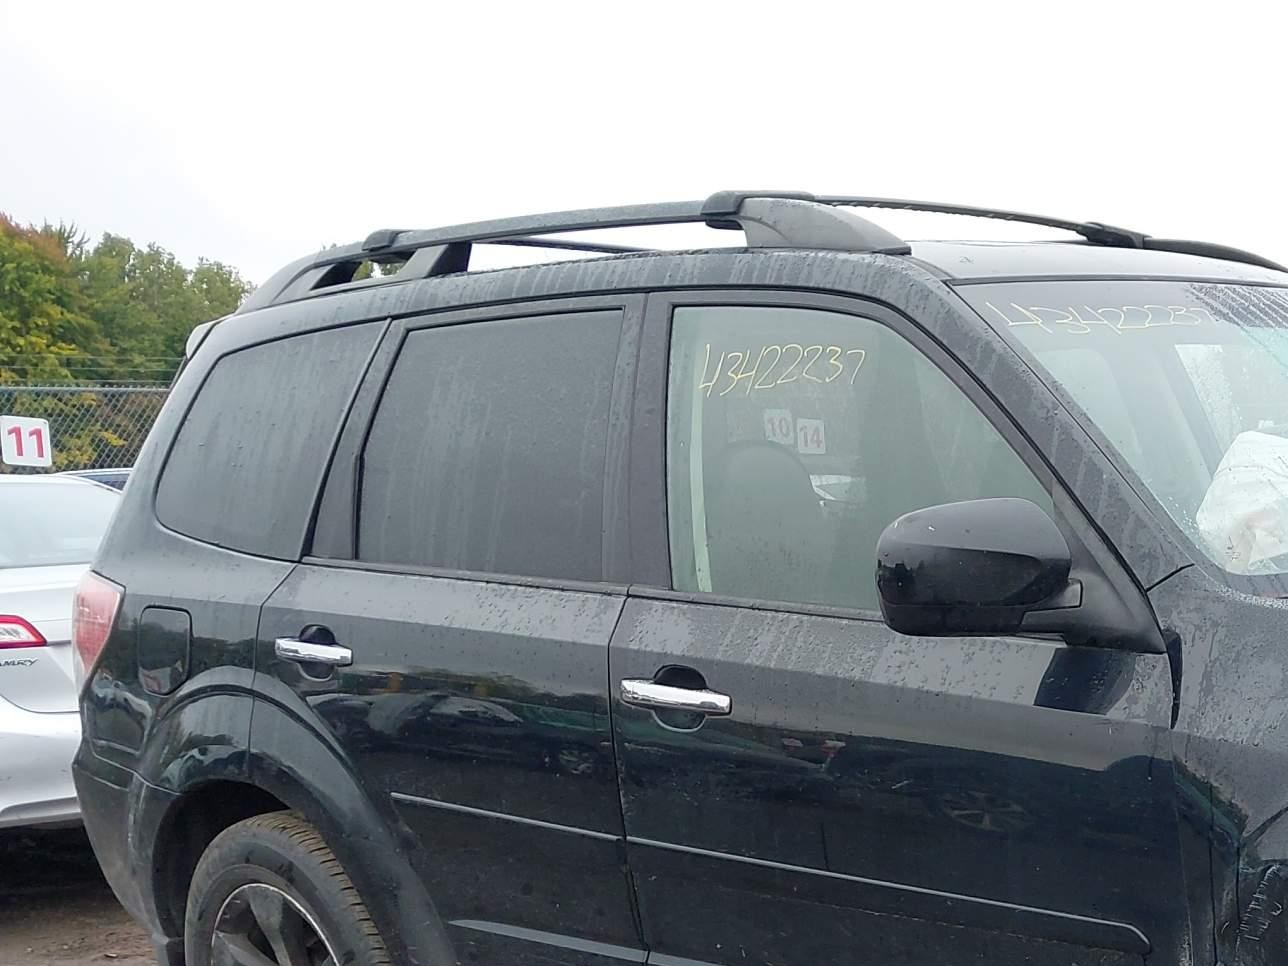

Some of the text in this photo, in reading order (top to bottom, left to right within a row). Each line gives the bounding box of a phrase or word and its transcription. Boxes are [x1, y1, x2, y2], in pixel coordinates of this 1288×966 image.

[698, 343, 866, 397] 43422237
[7, 426, 44, 458] 11
[800, 424, 823, 448] 14
